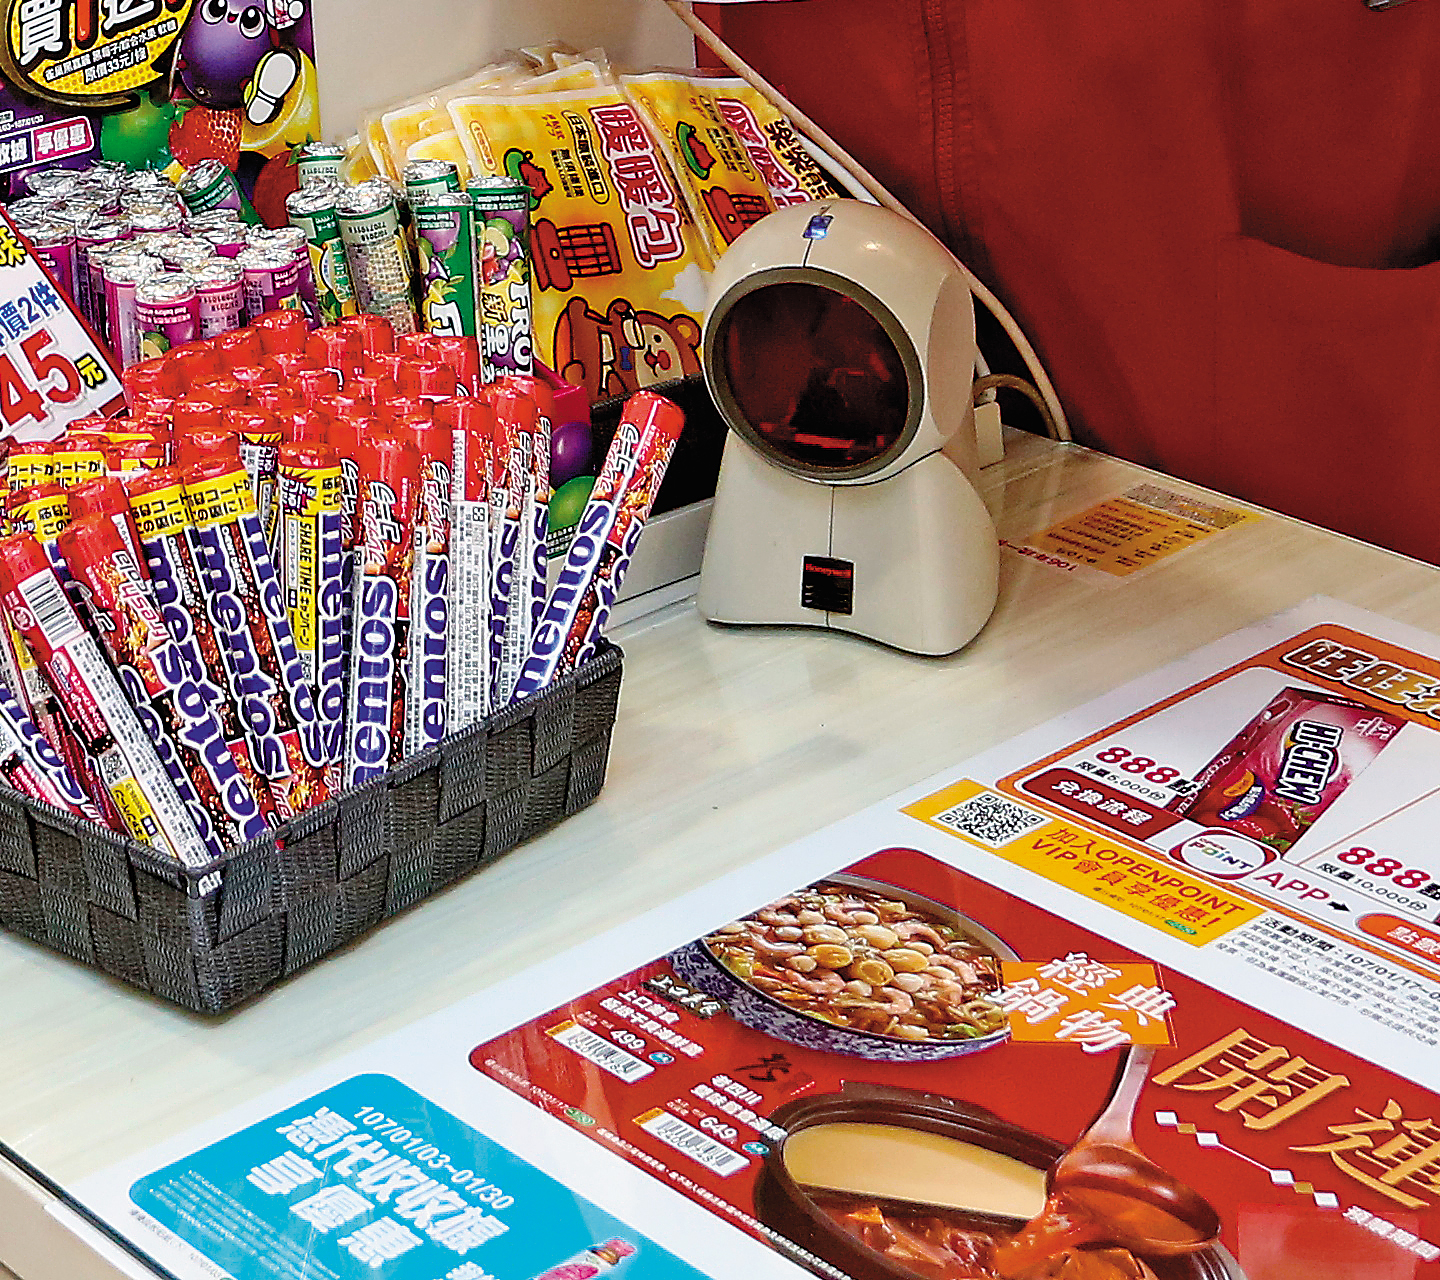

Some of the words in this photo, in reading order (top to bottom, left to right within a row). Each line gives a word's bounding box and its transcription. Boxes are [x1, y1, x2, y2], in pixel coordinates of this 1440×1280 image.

[589, 104, 684, 269] 暖暖包
[1046, 827, 1245, 915] 加入OPENPOINT
[1256, 871, 1330, 903] APP
[610, 1027, 646, 1051] 499
[354, 1104, 515, 1210] 107/01/03~01/30
[699, 1114, 738, 1140] 649
[246, 1151, 423, 1269] 享優惠
